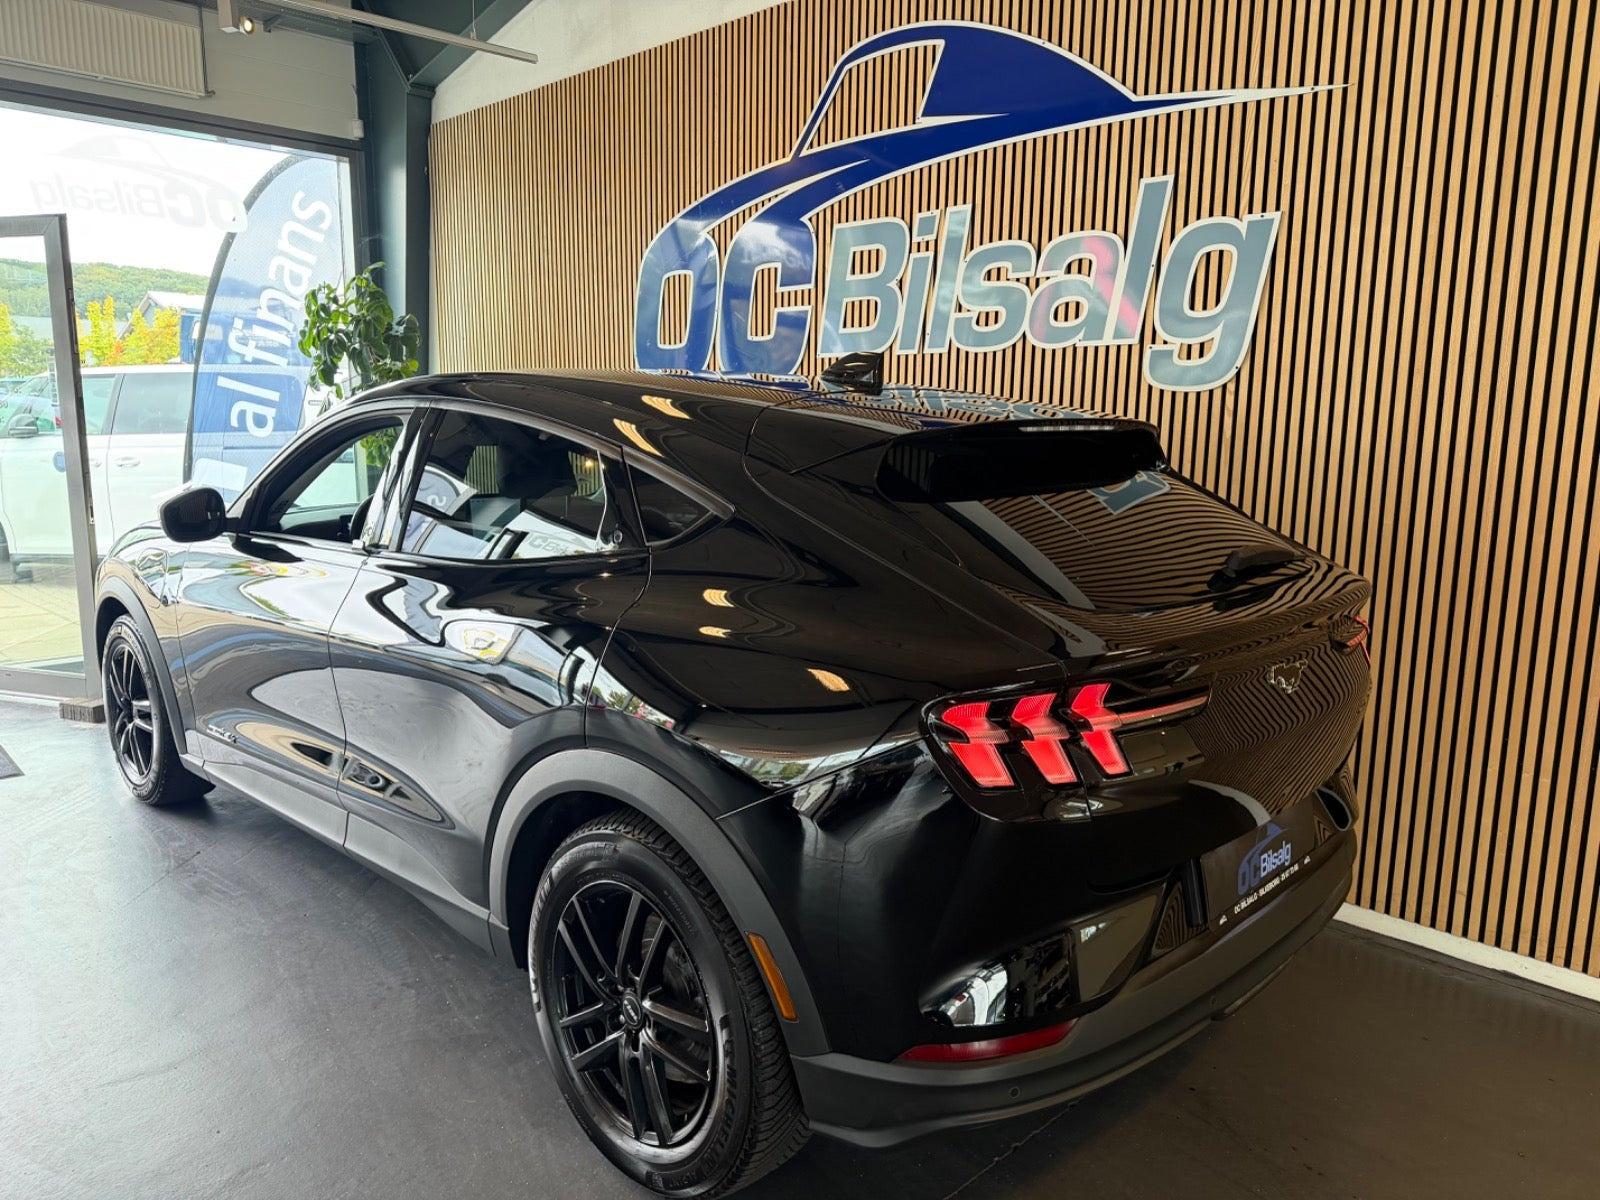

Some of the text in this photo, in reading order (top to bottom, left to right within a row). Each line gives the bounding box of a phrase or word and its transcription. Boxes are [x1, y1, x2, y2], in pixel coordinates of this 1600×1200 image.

[217, 190, 333, 438] al finans
[817, 174, 1284, 392] Bilsalg
[1260, 840, 1292, 878] Bilsalg
